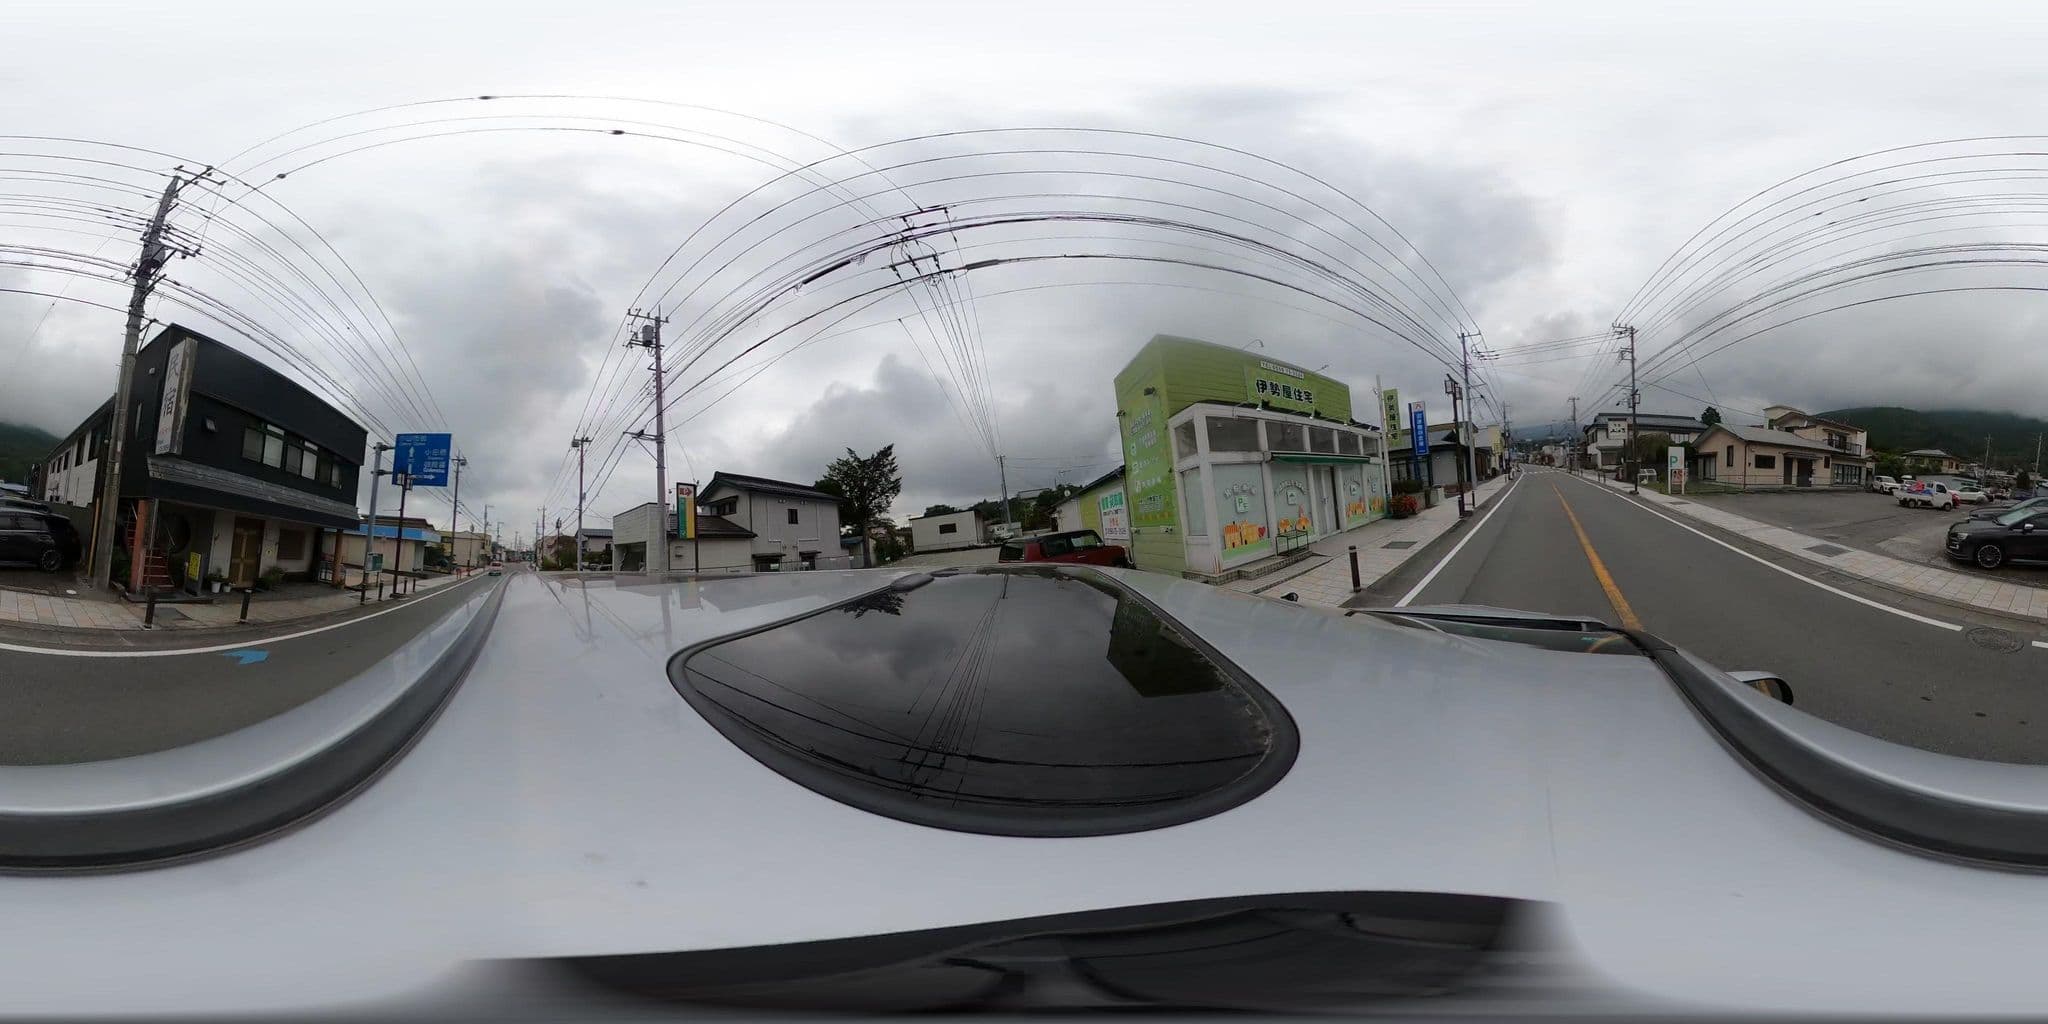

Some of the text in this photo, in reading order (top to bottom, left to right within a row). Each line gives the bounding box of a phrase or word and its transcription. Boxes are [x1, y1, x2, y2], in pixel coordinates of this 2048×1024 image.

[1256, 379, 1313, 404] 伊勢屋住宅
[1669, 455, 1678, 468] P
